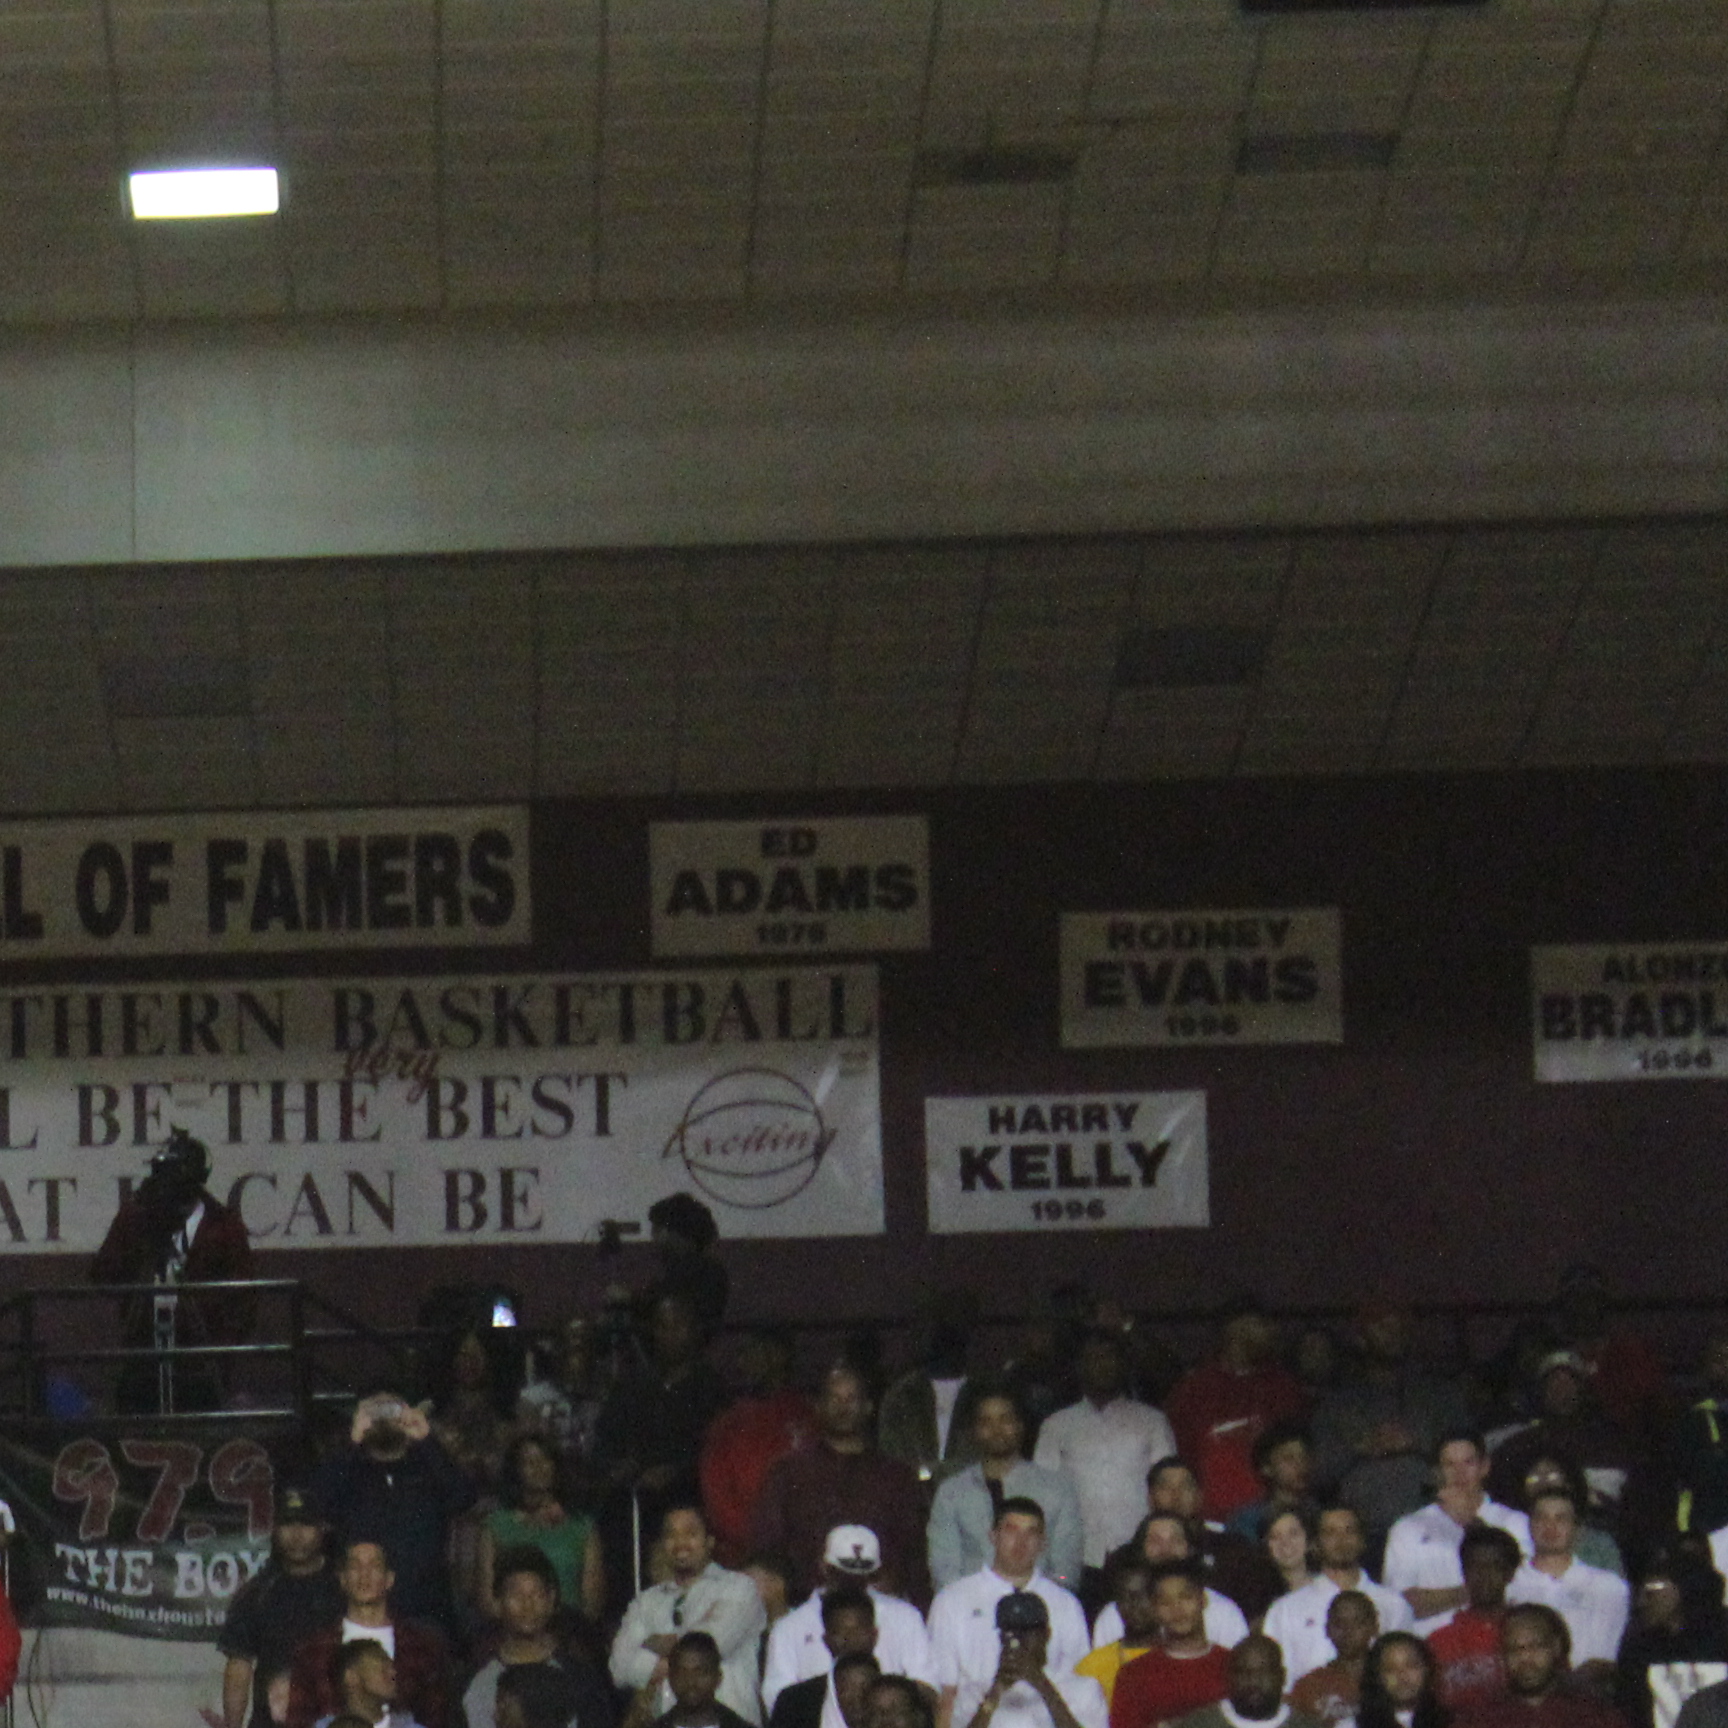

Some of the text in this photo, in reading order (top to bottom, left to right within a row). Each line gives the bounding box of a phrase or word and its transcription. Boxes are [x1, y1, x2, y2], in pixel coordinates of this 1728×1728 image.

[760, 829, 819, 859] ED
[75, 840, 174, 938] OF
[205, 828, 515, 934] FAMERS
[665, 863, 921, 916] ADAMS
[1107, 917, 1292, 954] RODNEY
[1083, 955, 1320, 1006] EVANS
[332, 968, 874, 1055] BASKETBALL
[76, 1081, 174, 1149] BE
[209, 1077, 383, 1145] THE
[424, 1072, 629, 1142] BEST
[988, 1103, 1142, 1137] HARRY
[957, 1139, 1173, 1195] KELLY
[227, 1171, 397, 1236] CAN
[444, 1166, 545, 1235] BE
[52, 1438, 275, 1546] 97.9
[55, 1543, 154, 1597] THE
